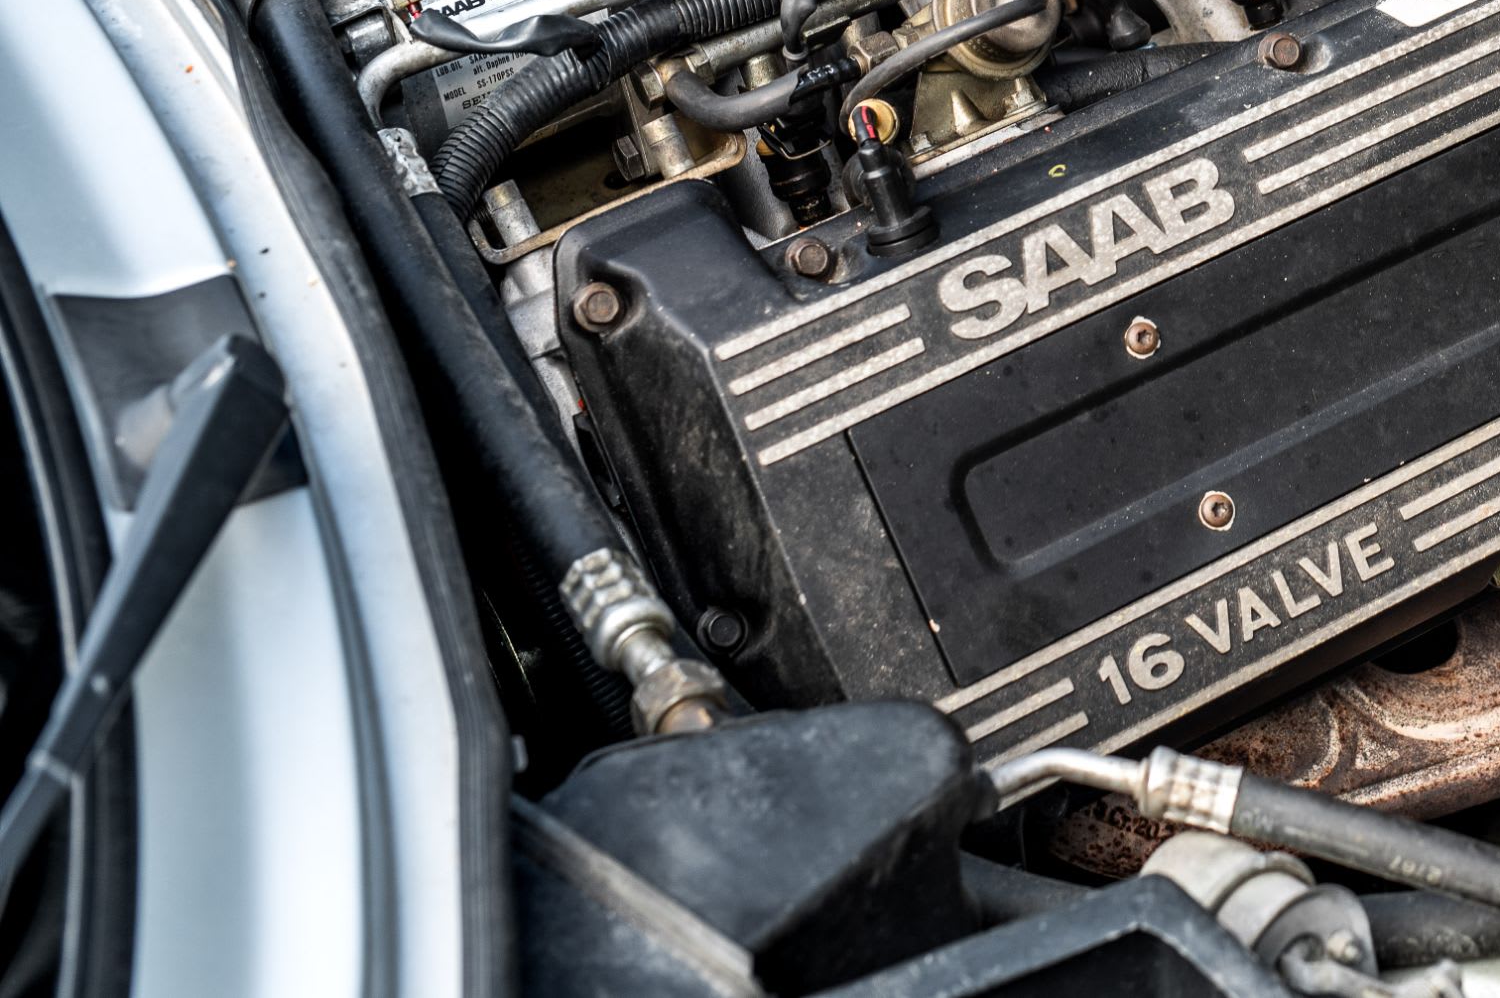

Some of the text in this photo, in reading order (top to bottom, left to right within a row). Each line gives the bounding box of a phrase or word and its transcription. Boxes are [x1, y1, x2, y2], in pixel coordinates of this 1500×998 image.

[443, 87, 467, 101] MODEL
[938, 158, 1235, 340] SAAB
[1098, 522, 1395, 705] 16 VALVE
